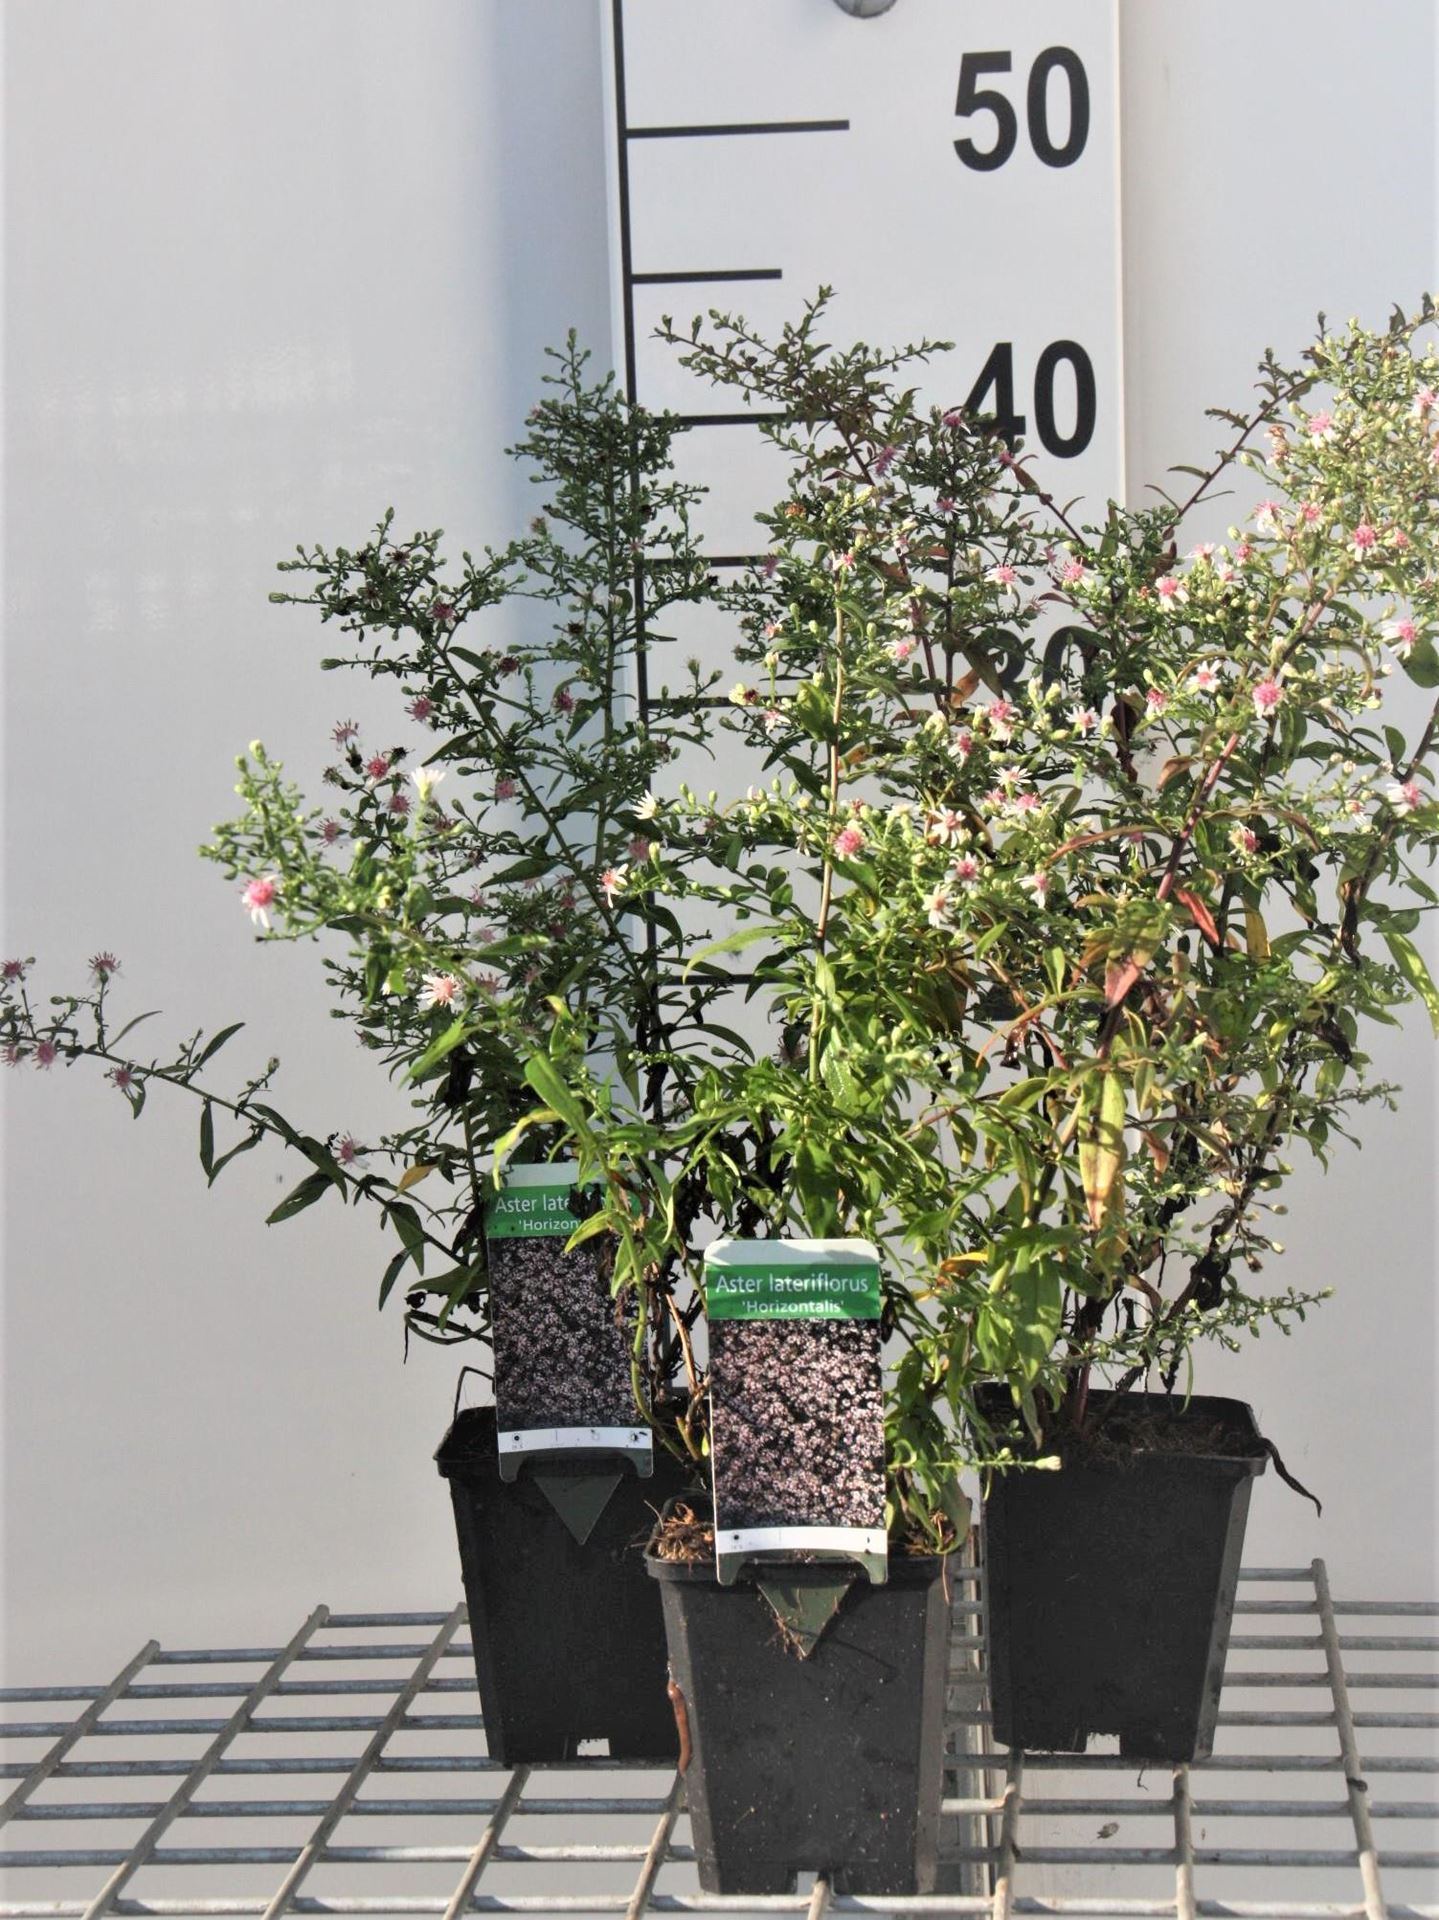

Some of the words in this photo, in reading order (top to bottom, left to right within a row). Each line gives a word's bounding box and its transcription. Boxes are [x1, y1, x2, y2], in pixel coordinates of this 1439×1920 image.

[953, 46, 1090, 172] 50
[962, 340, 1096, 458] 40
[495, 1196, 538, 1213] Aster
[519, 1218, 582, 1232] 'Horizon
[715, 1274, 763, 1294] Aster
[769, 1272, 869, 1293] lateriflorus
